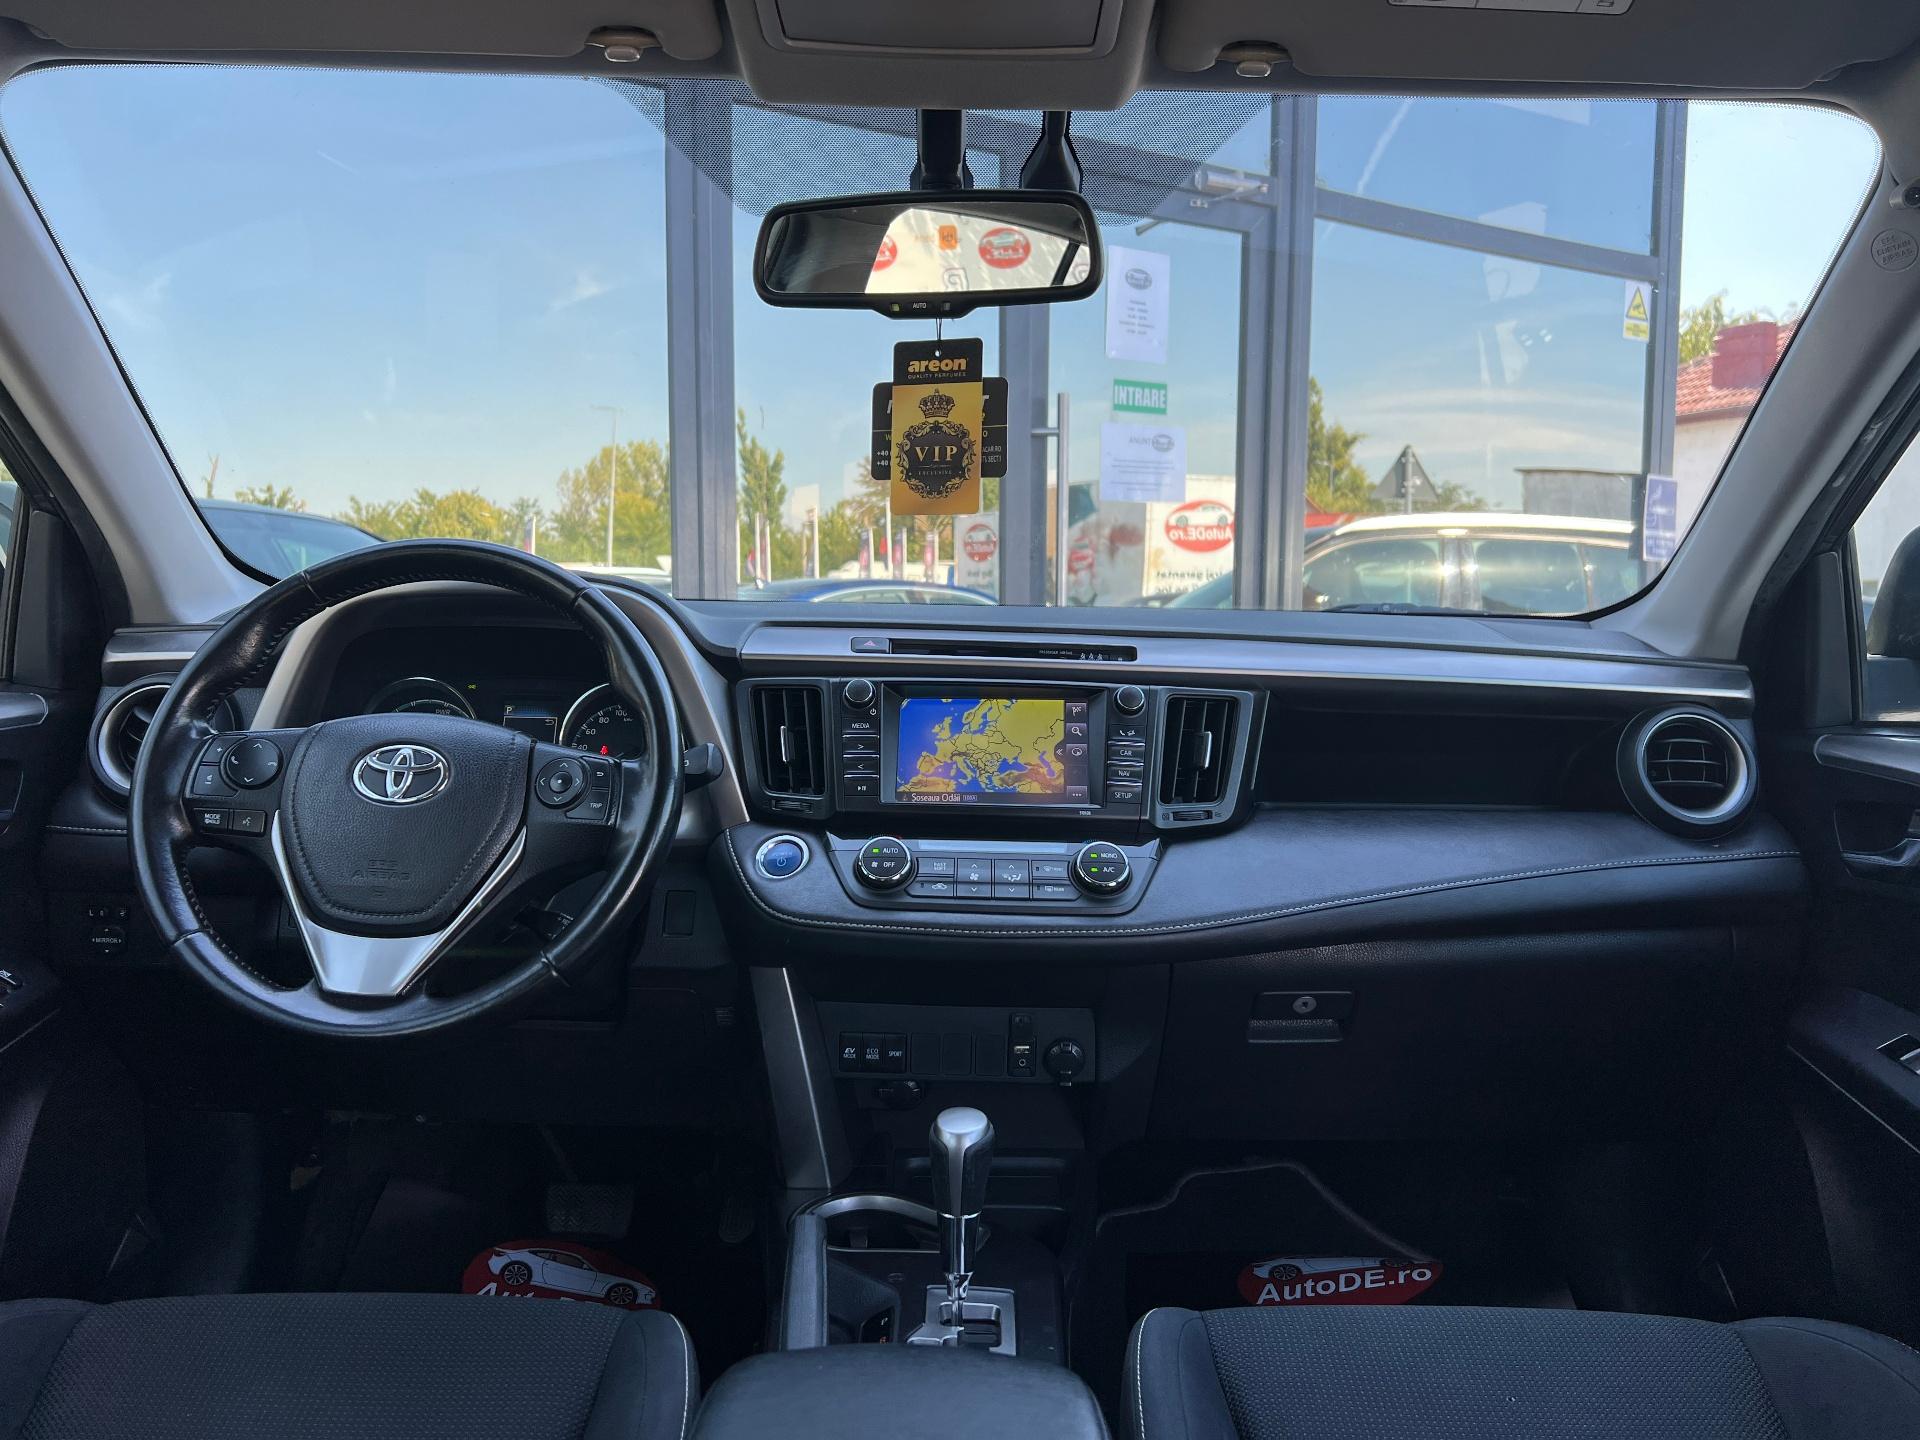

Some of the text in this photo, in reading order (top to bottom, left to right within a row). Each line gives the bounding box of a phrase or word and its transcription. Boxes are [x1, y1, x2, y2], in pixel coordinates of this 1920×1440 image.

[907, 358, 967, 373] areon
[1114, 384, 1167, 409] INTRARE
[914, 445, 958, 462] VIP
[506, 706, 513, 715] P
[598, 716, 610, 724] 80
[585, 728, 596, 736] 60
[1255, 1267, 1433, 1305] AutoDE.ro
